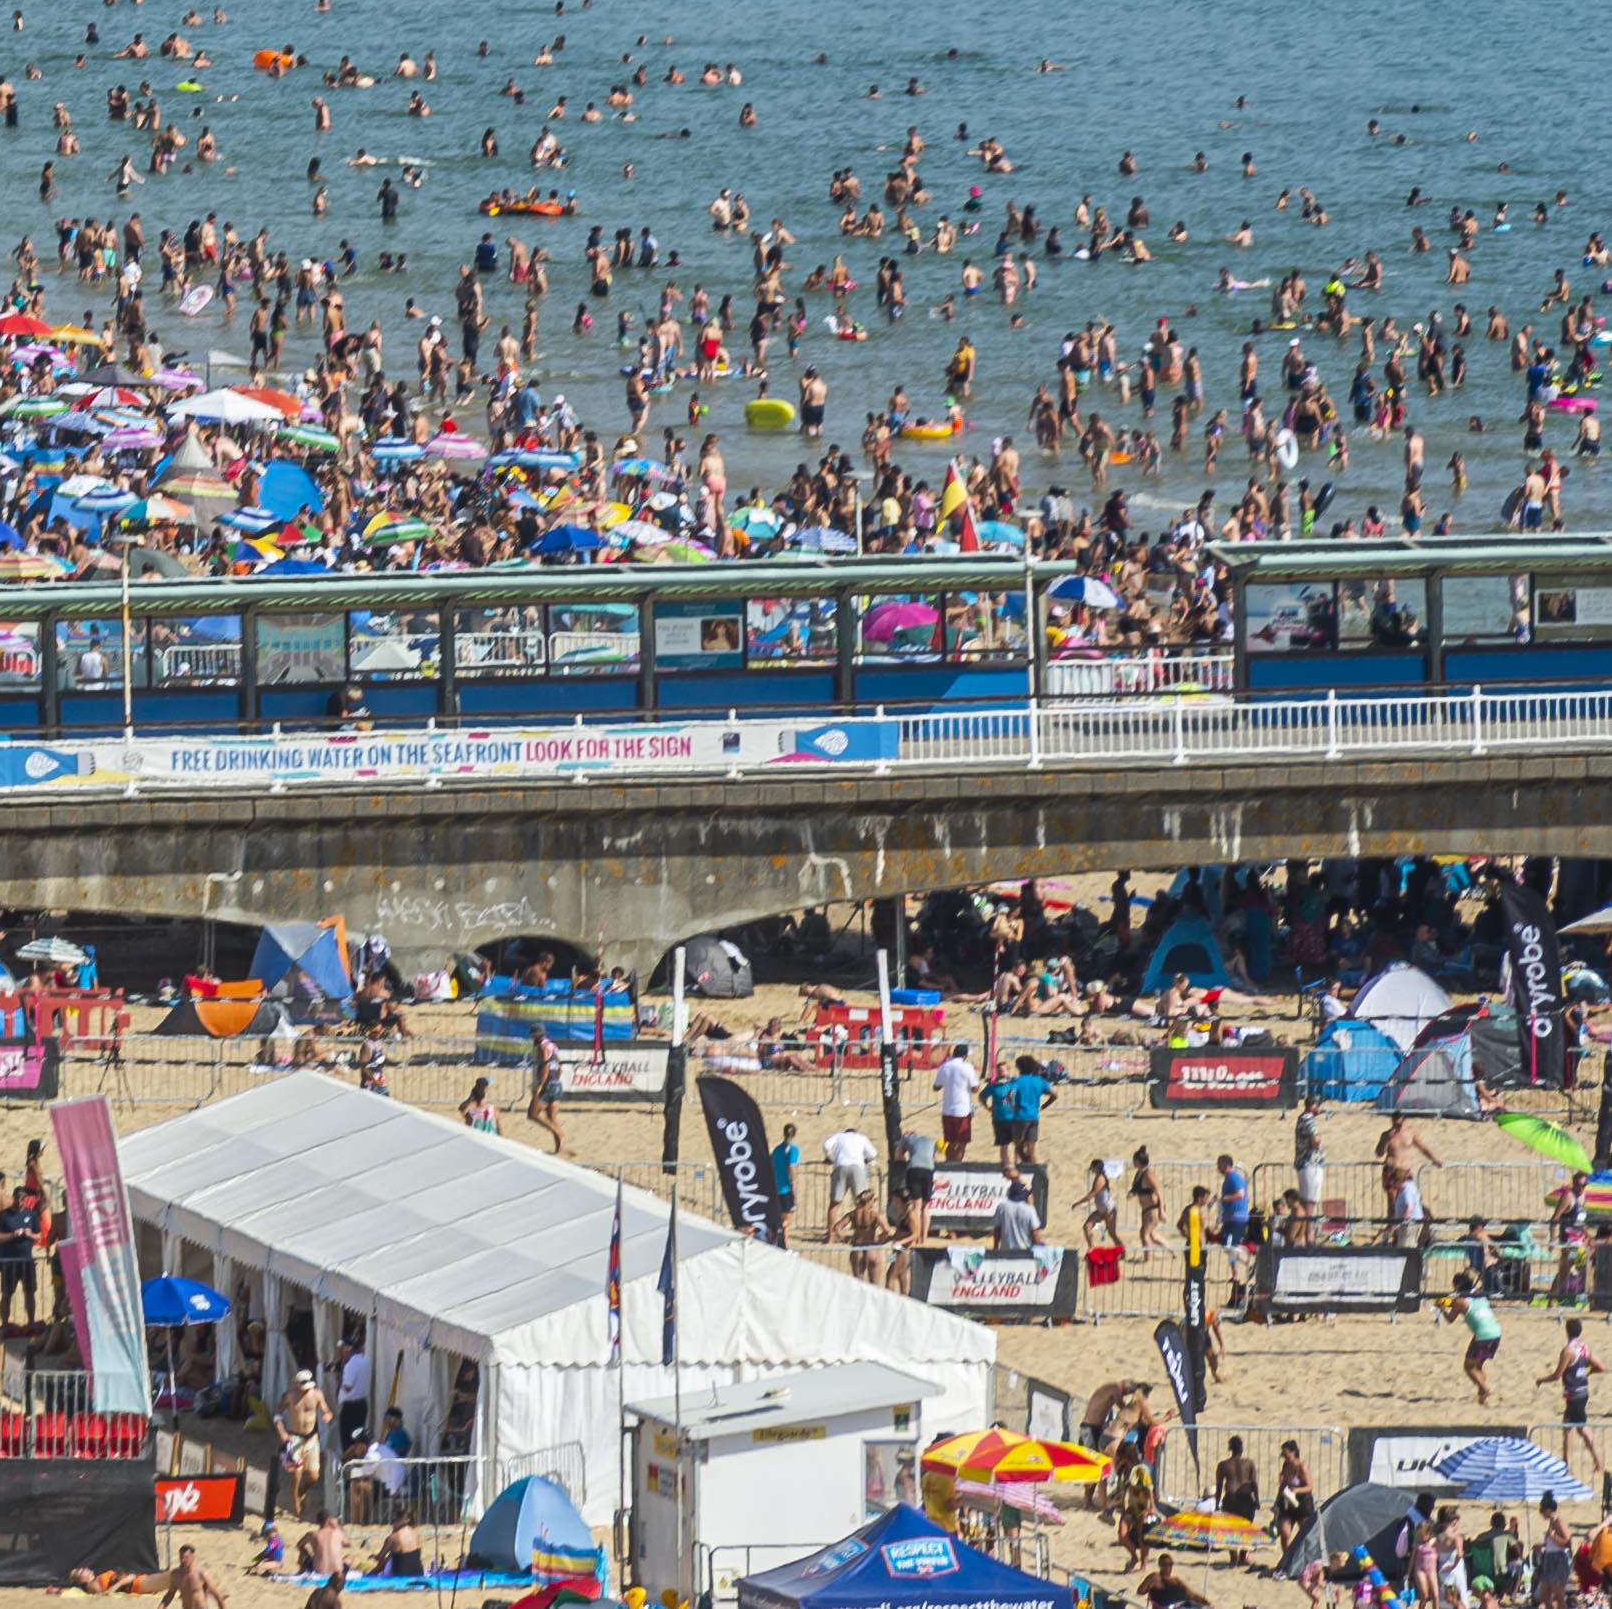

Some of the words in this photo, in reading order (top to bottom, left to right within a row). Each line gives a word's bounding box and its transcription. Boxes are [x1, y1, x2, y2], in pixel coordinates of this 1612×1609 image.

[171, 749, 210, 771] FREE
[215, 748, 303, 770] DRINKING
[308, 746, 363, 768] WATER
[367, 745, 392, 766] ON
[396, 743, 428, 765] THE
[433, 741, 522, 764] SEAFRONT
[526, 739, 576, 762] LOOK
[577, 739, 609, 760] FOR
[615, 738, 645, 759] THE
[649, 736, 692, 758] SIGN
